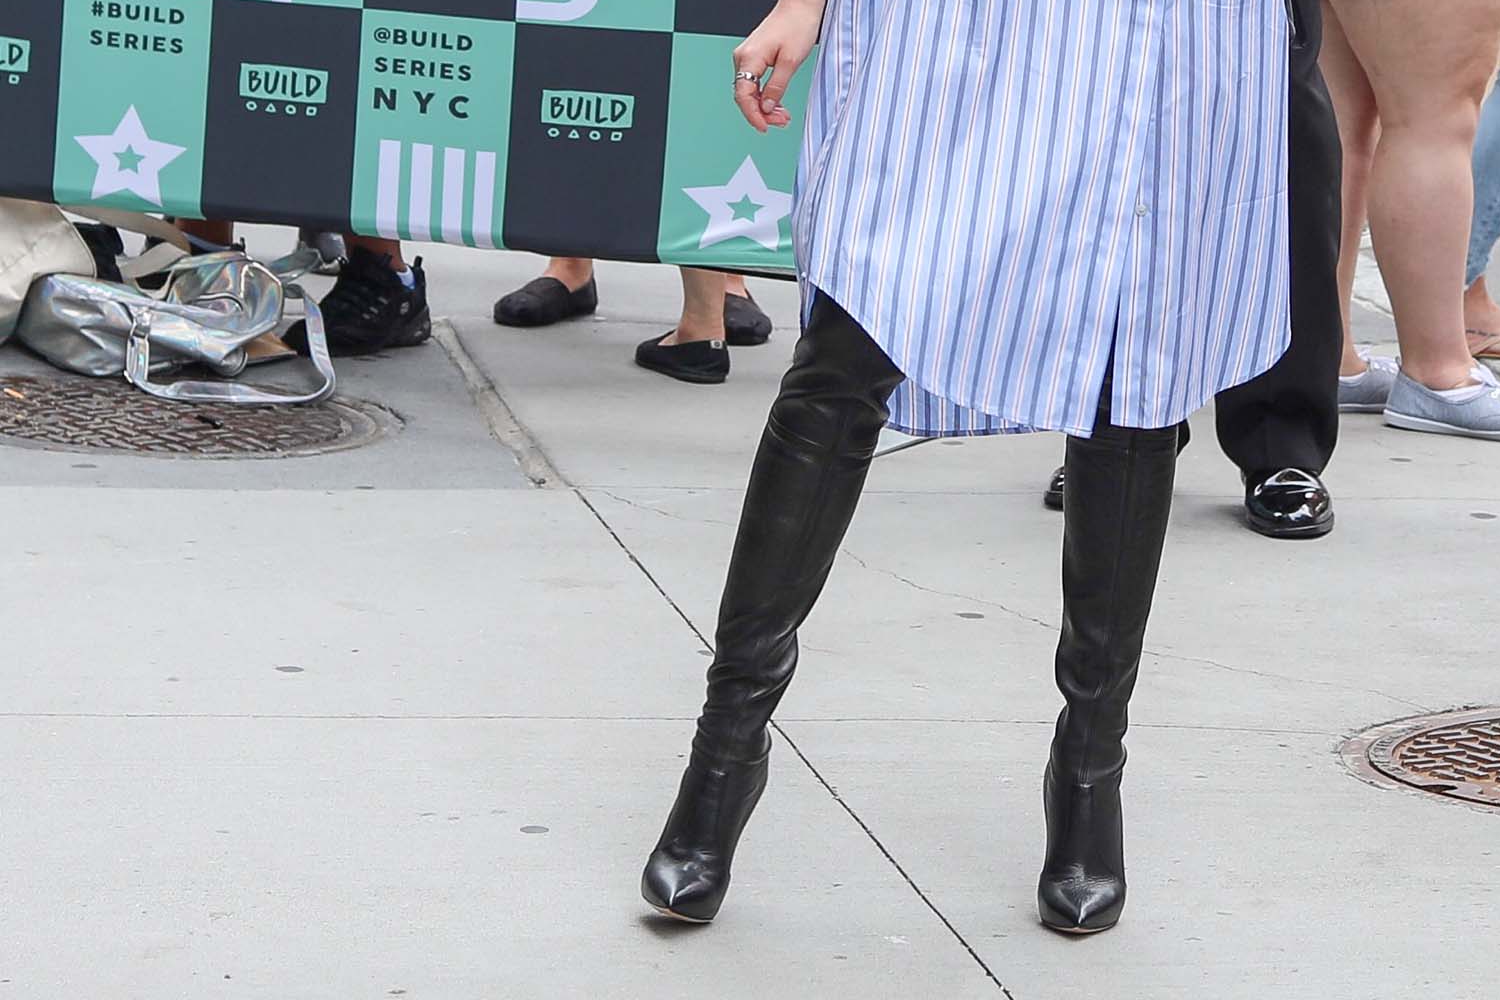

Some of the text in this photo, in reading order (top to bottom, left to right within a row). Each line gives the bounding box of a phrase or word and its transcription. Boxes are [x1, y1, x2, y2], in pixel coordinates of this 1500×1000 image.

[91, 0, 185, 25] #BUILD
[90, 29, 183, 54] SERIES
[373, 27, 473, 52] @BUILD
[374, 56, 472, 82] SERIES
[248, 70, 322, 99] BUILD
[373, 87, 470, 119] NYC
[550, 95, 628, 124] BUILD
